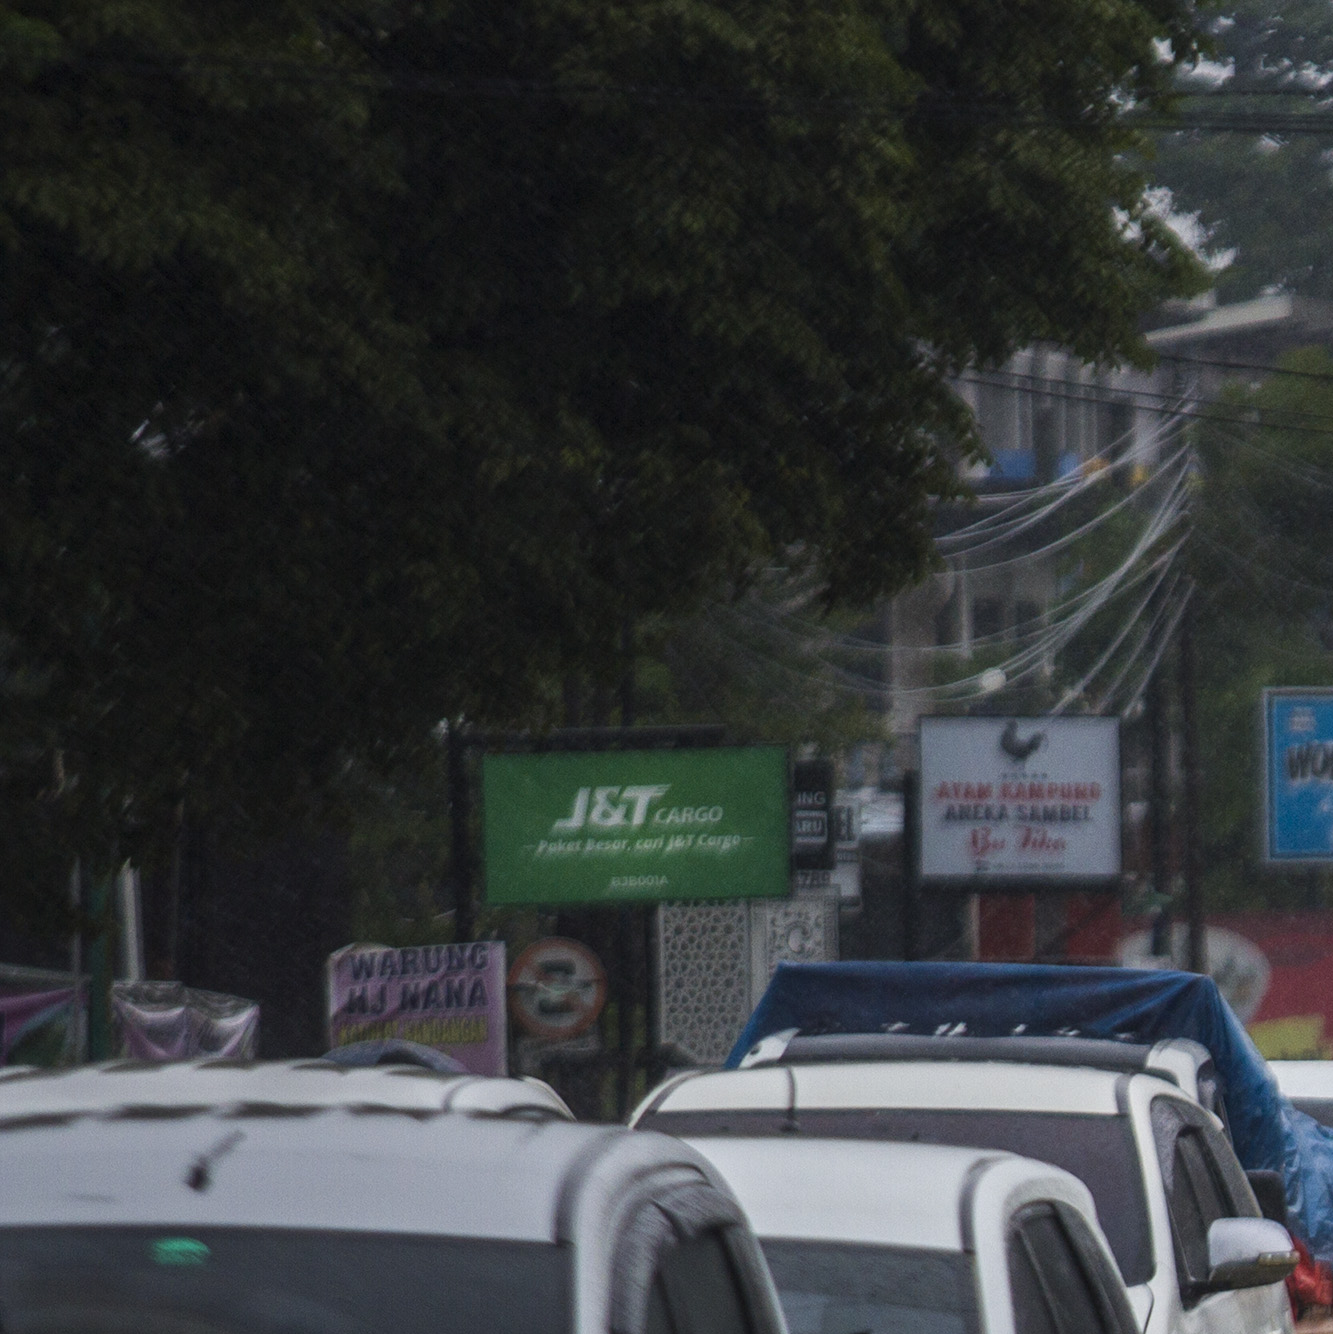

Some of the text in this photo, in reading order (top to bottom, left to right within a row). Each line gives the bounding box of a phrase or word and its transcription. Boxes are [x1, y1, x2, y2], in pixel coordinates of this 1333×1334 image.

[936, 781, 1101, 800] AYAM KAMPUNG
[552, 784, 724, 830] J&T CARGO
[944, 804, 1009, 821] ANEKA
[538, 839, 582, 855] Paket
[636, 836, 664, 850] cari
[666, 835, 695, 852] J&T
[698, 834, 742, 851] Cargo
[350, 943, 489, 980] WARUNG
